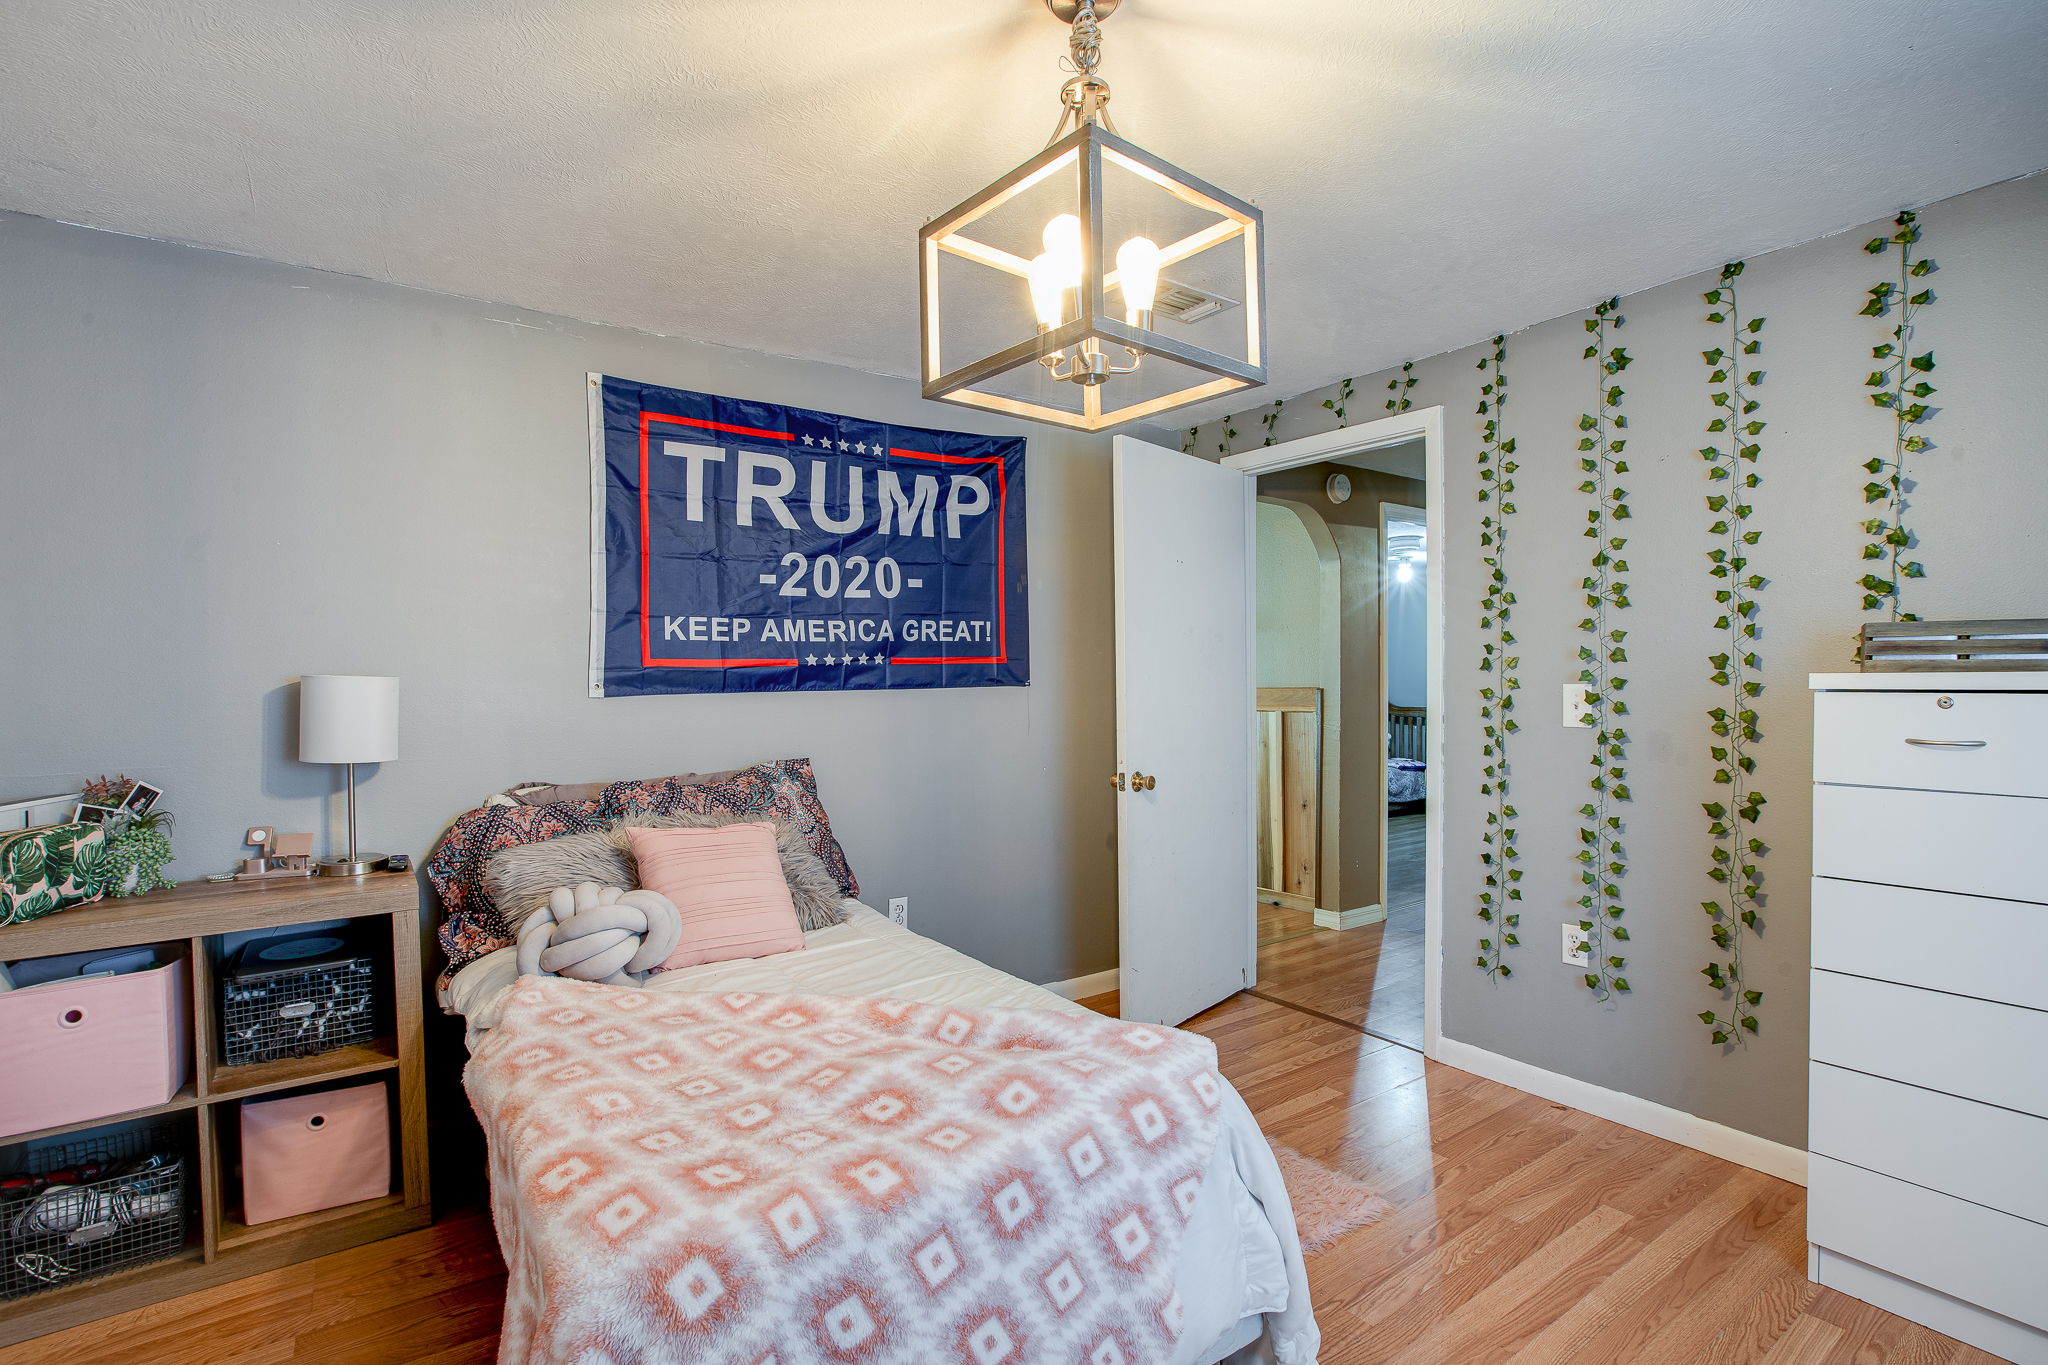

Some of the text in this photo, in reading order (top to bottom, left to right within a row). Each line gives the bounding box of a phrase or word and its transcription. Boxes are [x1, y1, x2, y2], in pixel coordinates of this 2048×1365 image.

[664, 441, 990, 539] TRUMP
[760, 552, 923, 599] -2020-
[664, 616, 992, 642] KEEP AMERICA GREAT!
